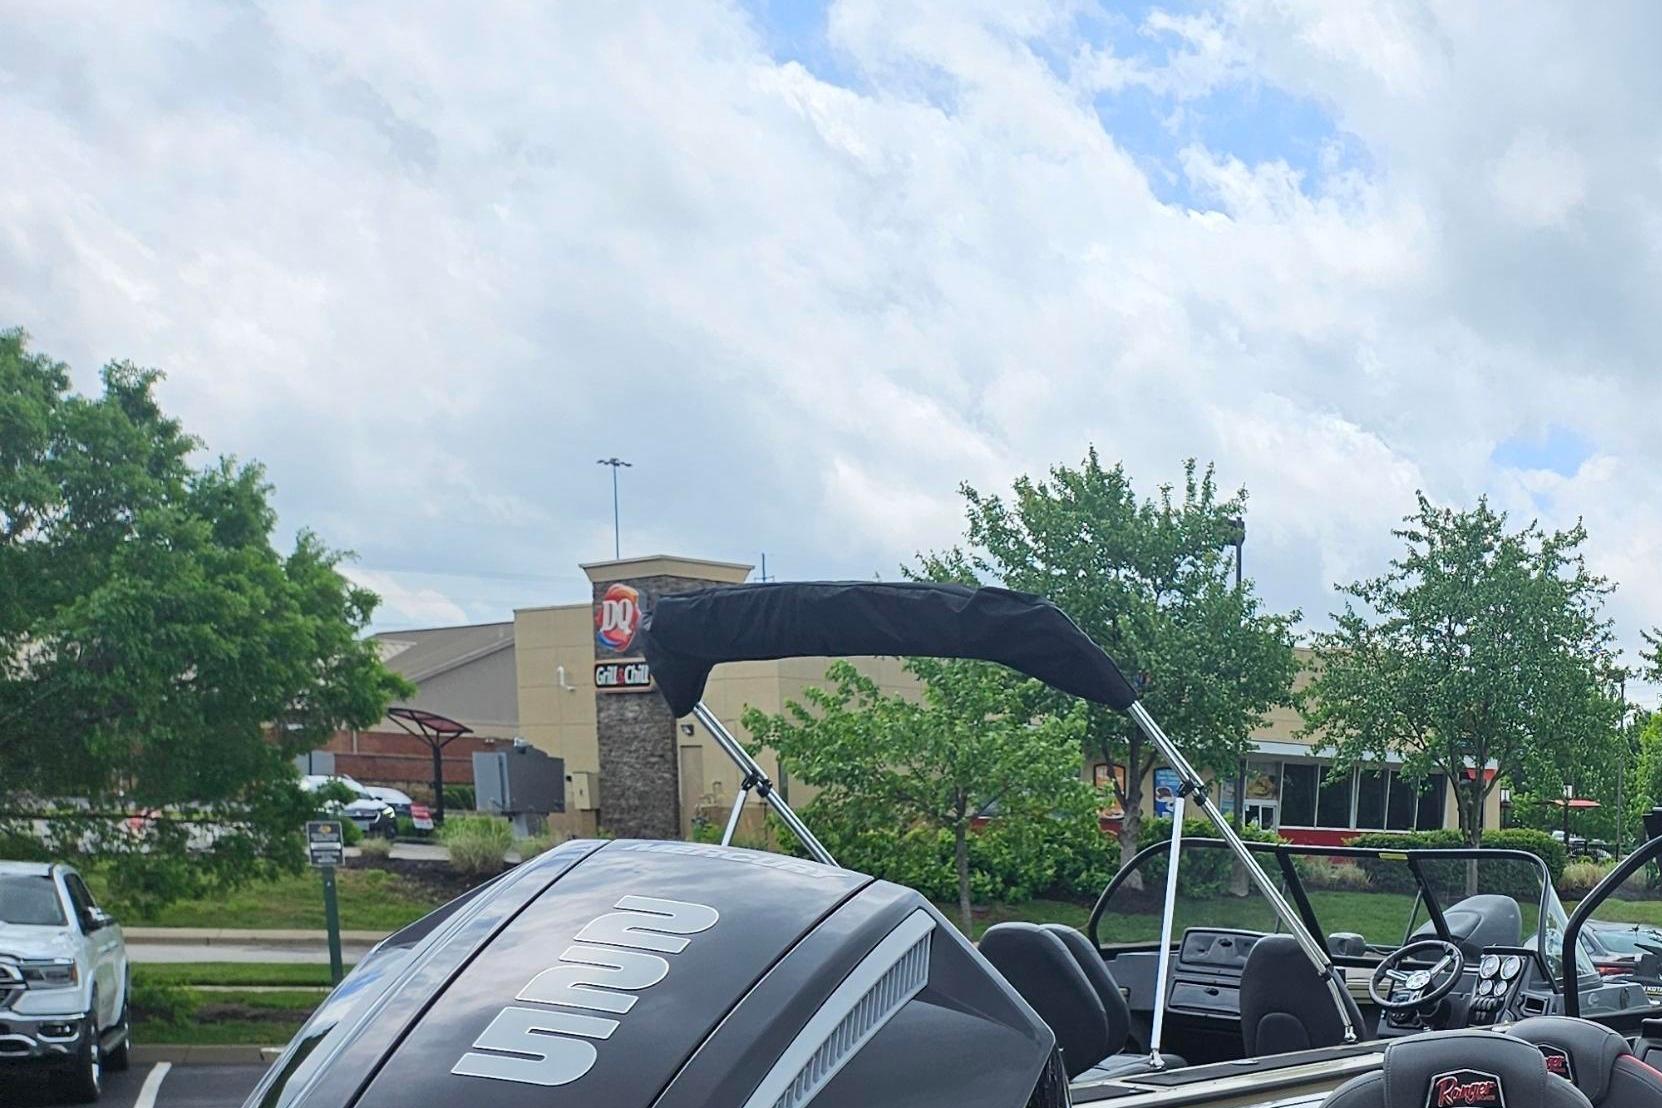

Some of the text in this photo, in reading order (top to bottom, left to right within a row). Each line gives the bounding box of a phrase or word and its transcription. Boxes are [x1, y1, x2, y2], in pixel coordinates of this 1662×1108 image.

[600, 599, 634, 635] DQ
[596, 666, 618, 685] Grill
[624, 664, 650, 684] Chill
[1435, 1075, 1497, 1108] Ranger
